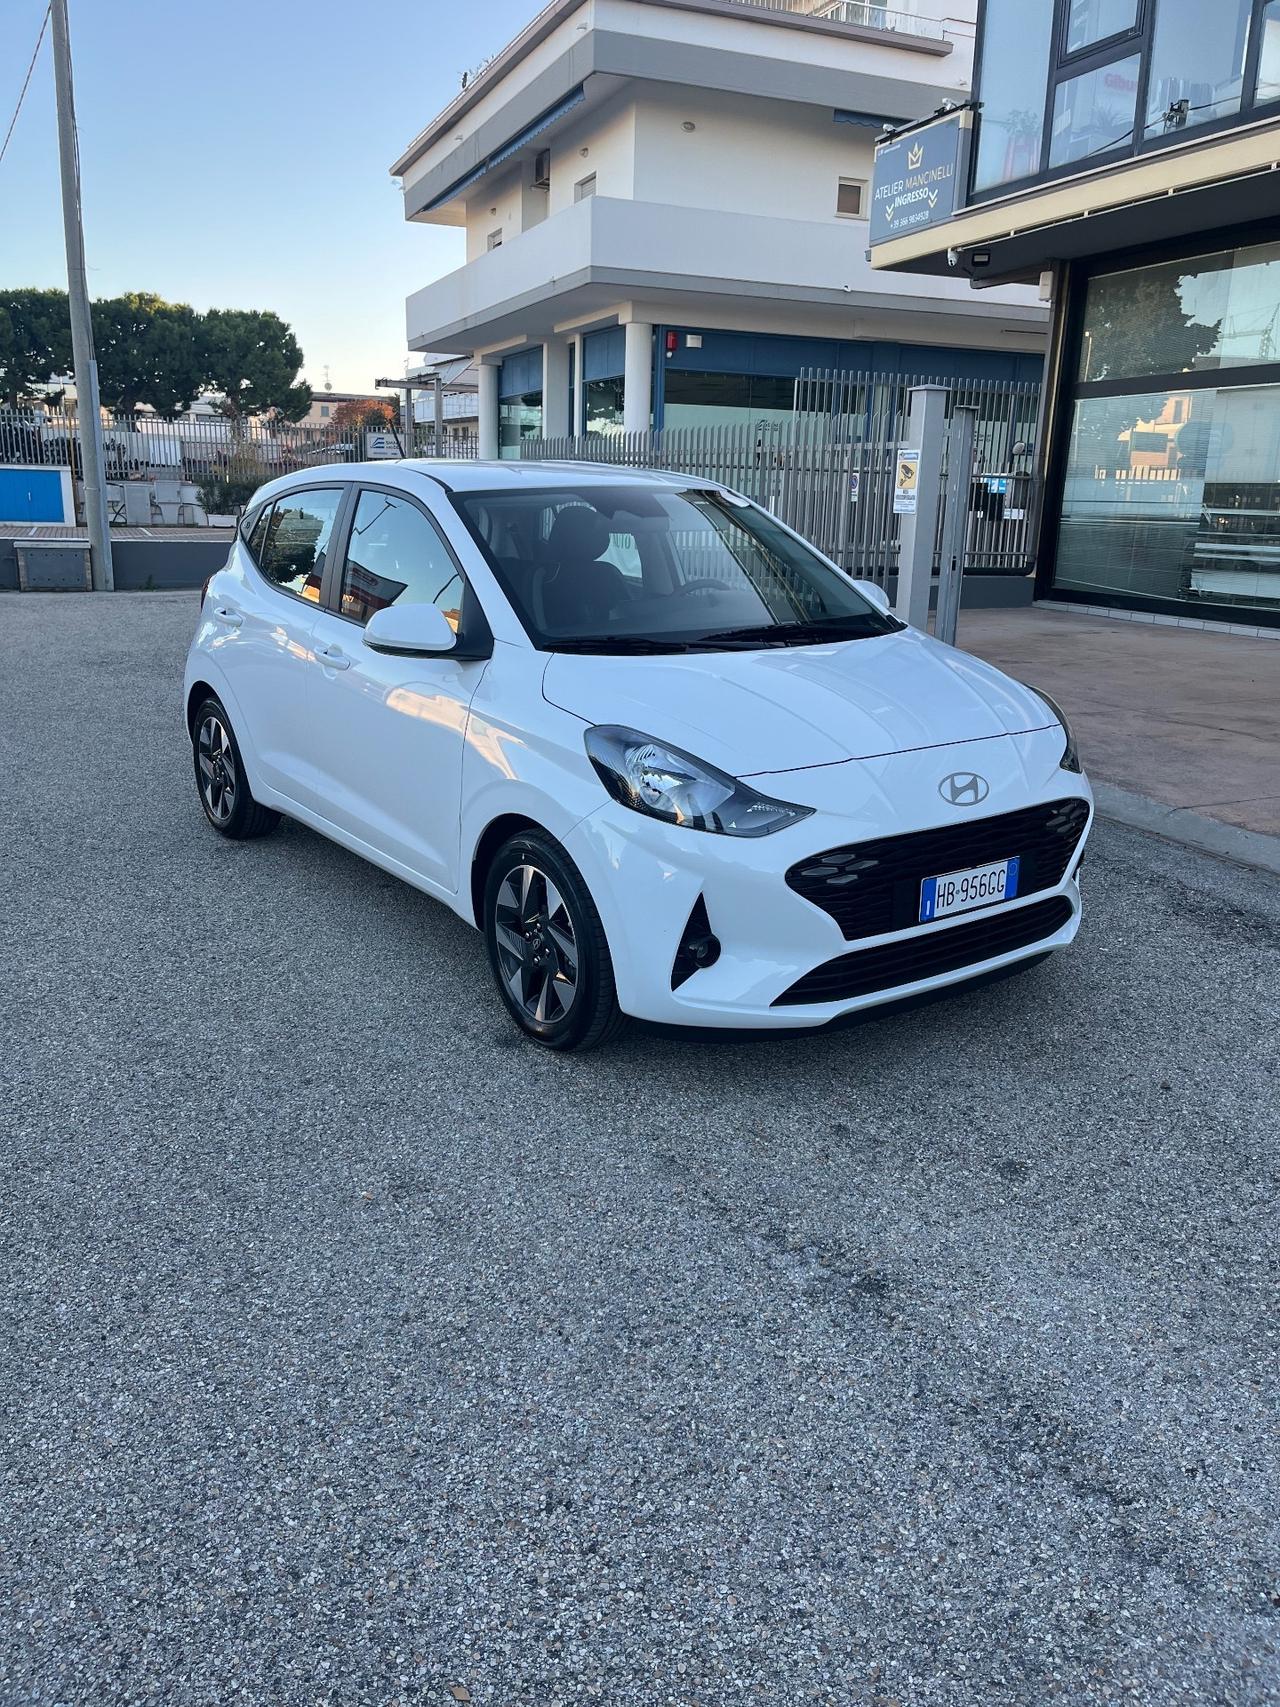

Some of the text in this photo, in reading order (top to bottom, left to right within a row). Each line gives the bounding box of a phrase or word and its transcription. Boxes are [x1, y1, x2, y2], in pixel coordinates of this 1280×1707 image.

[874, 163, 953, 200] ATELIER MANCINELLI
[894, 188, 928, 208] INGRESSO
